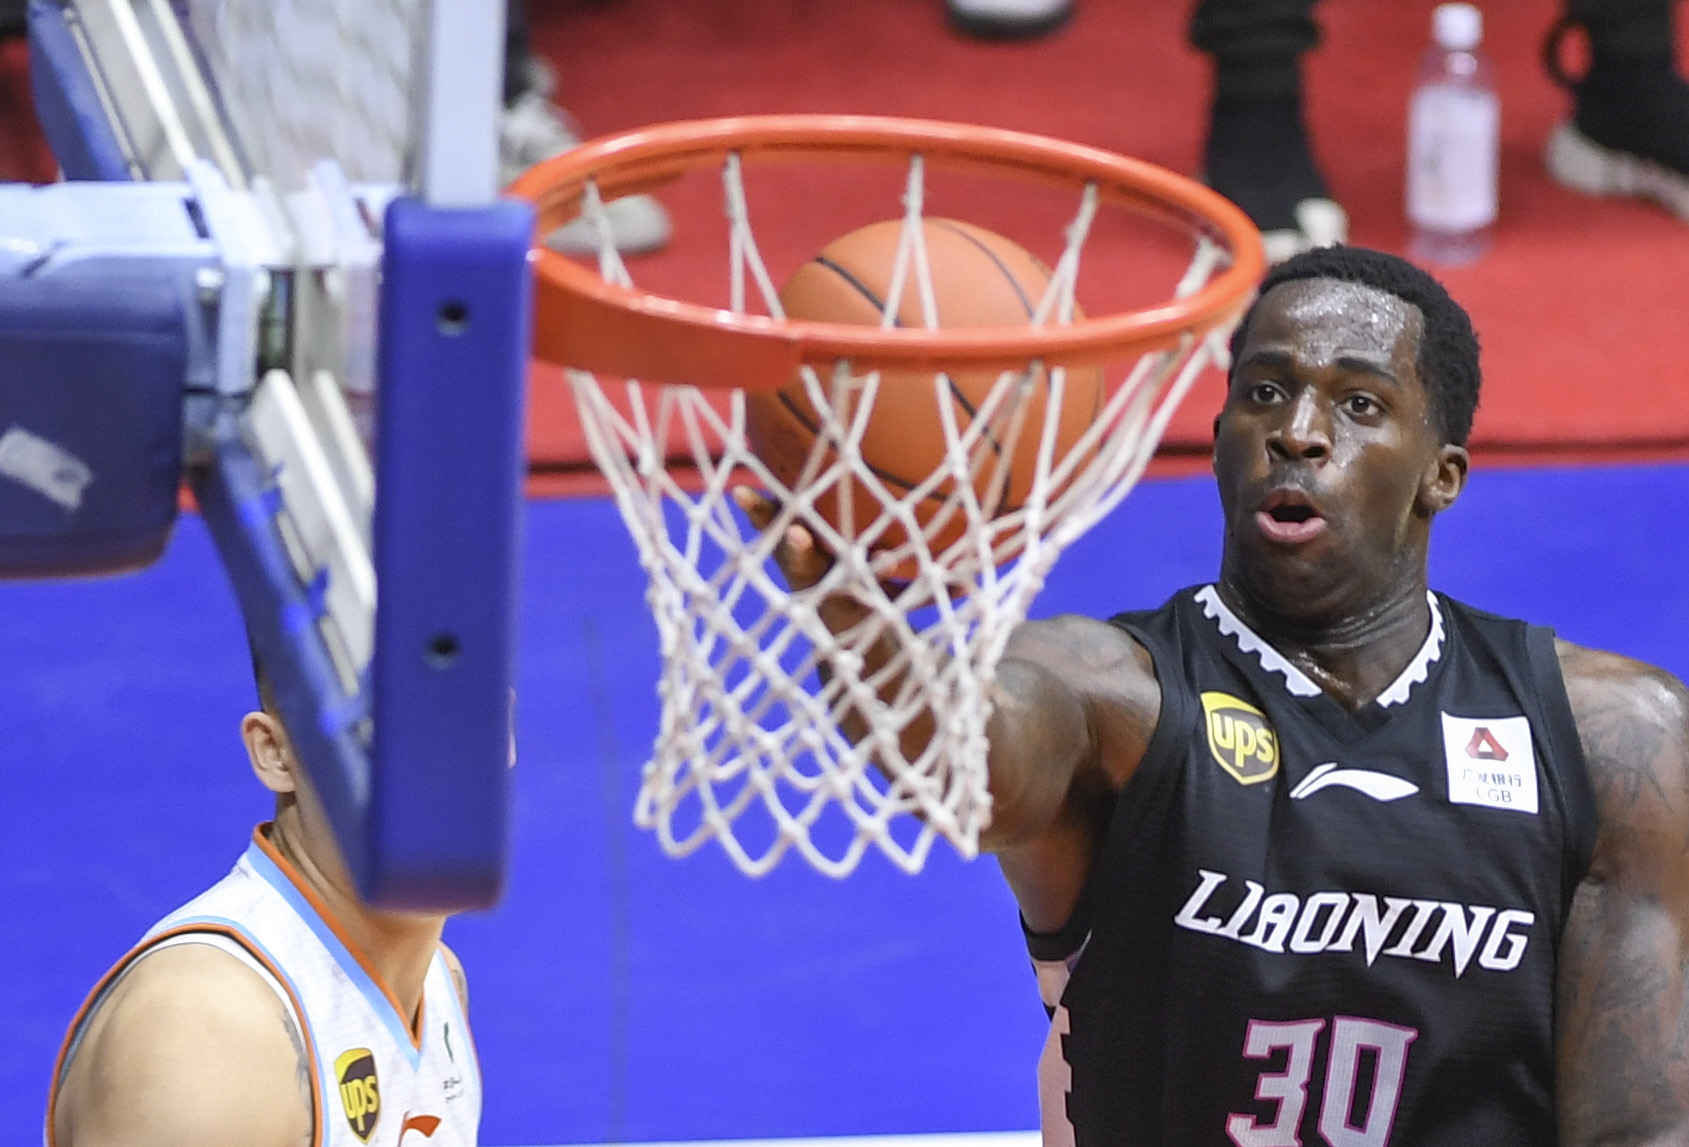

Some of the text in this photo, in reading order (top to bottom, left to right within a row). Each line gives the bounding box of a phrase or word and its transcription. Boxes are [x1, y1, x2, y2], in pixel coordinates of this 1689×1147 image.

[1211, 712, 1275, 768] ups
[1476, 787, 1512, 803] CGB
[1174, 869, 1535, 980] LIAONING
[340, 1075, 378, 1132] ups
